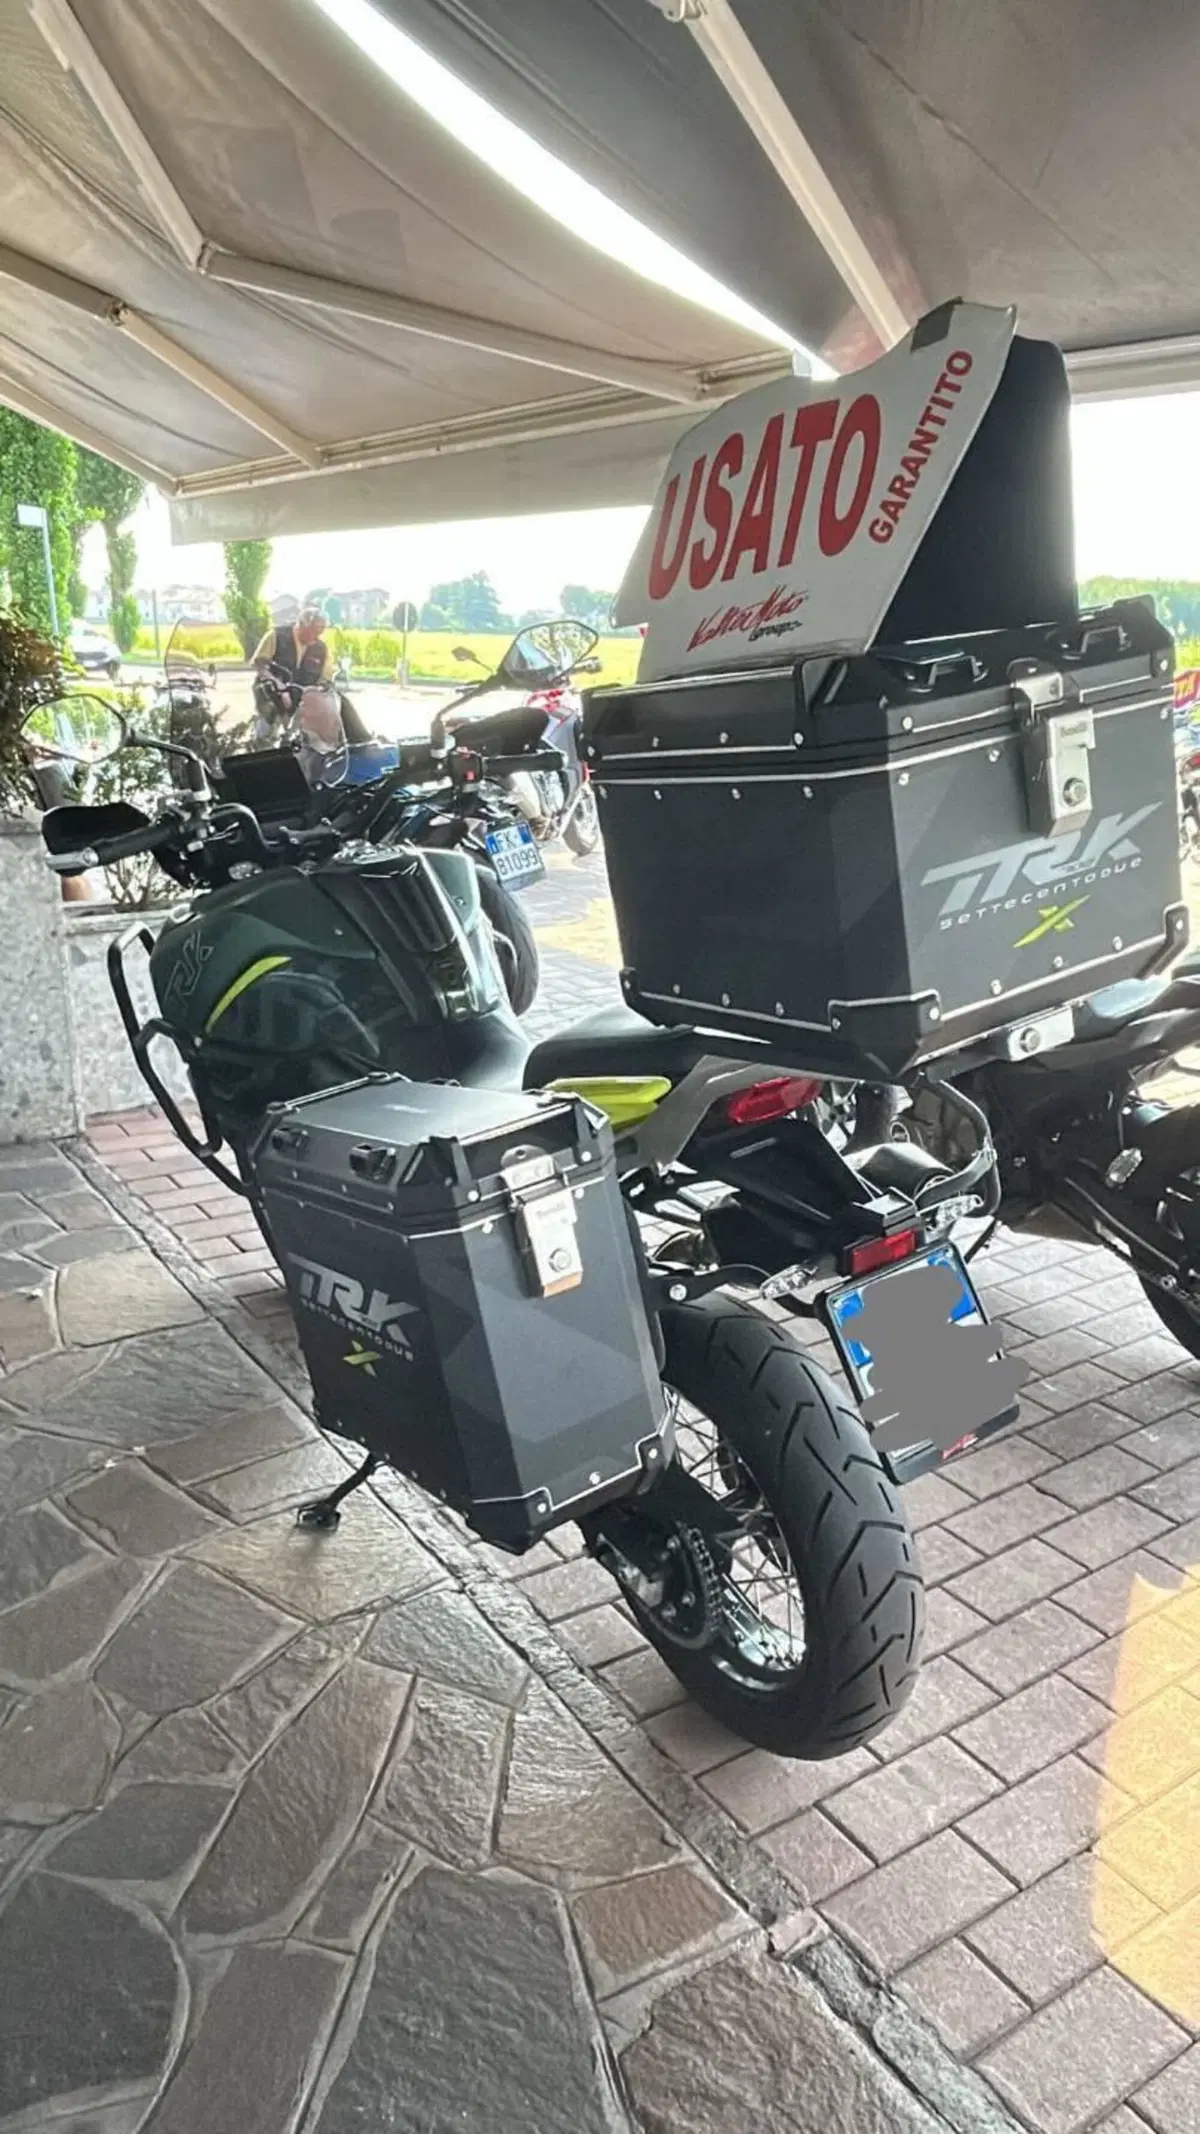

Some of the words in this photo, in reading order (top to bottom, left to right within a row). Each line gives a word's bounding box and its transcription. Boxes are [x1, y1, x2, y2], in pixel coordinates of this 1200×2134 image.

[648, 393, 882, 600] USATO
[868, 350, 974, 544] GARANTITO
[920, 801, 1164, 917] TRK
[287, 1252, 419, 1347] TRK
